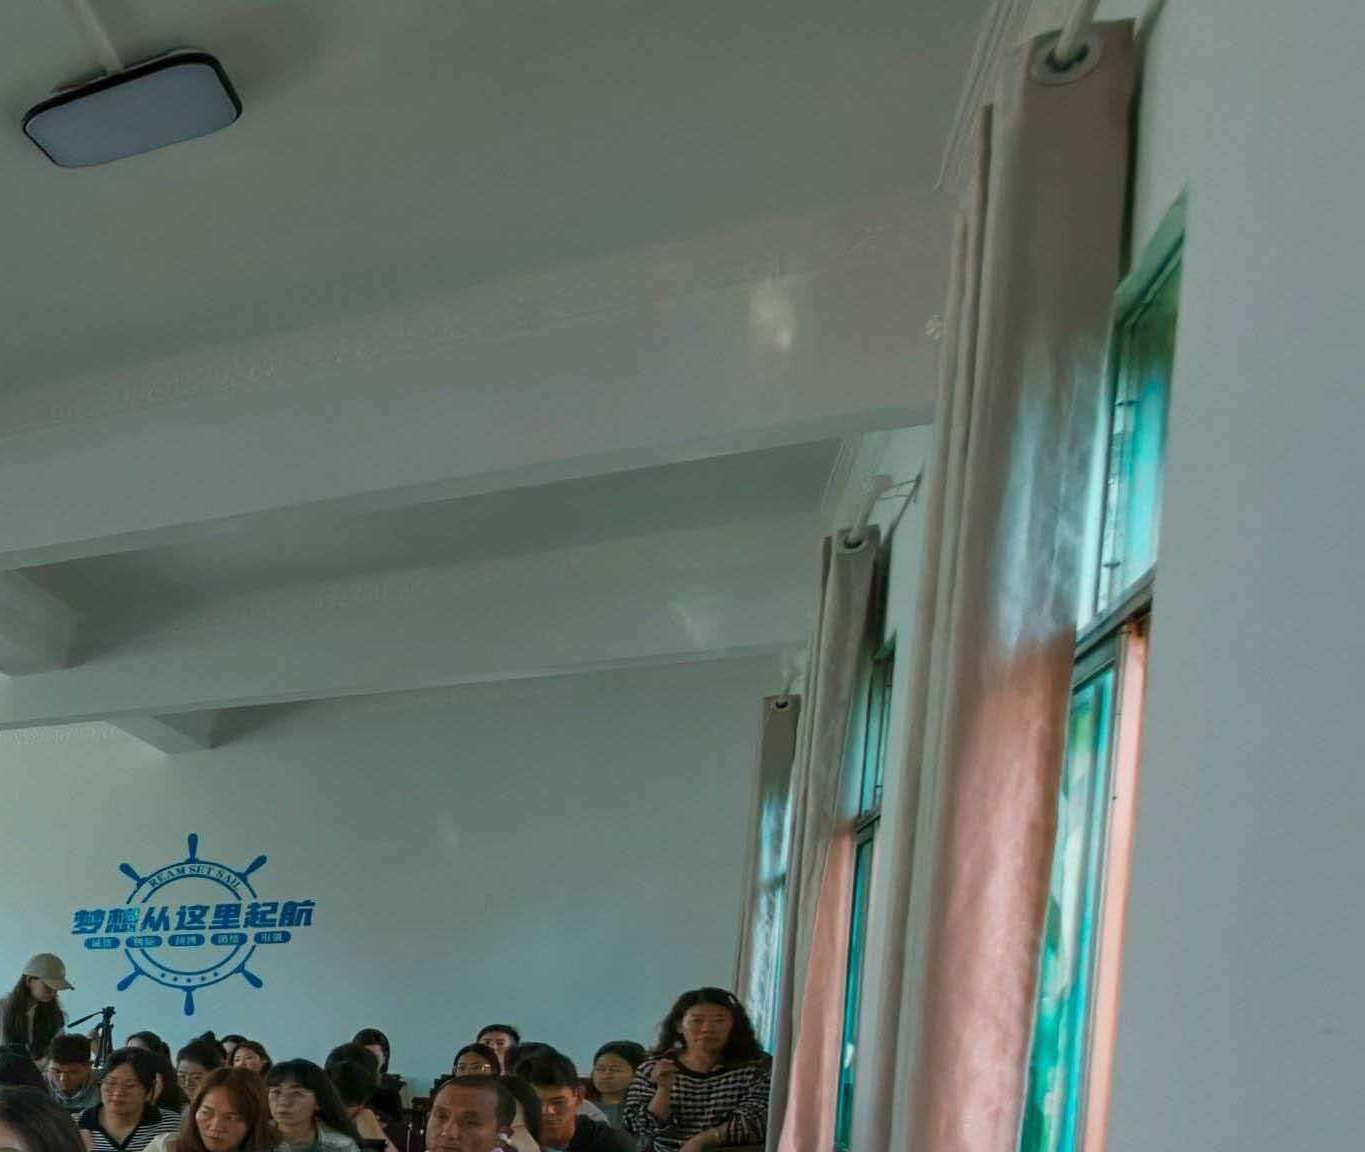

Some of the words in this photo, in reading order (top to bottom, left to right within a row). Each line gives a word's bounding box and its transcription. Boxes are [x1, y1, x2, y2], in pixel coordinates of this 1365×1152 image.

[71, 900, 316, 935] 梦想从这里起航
